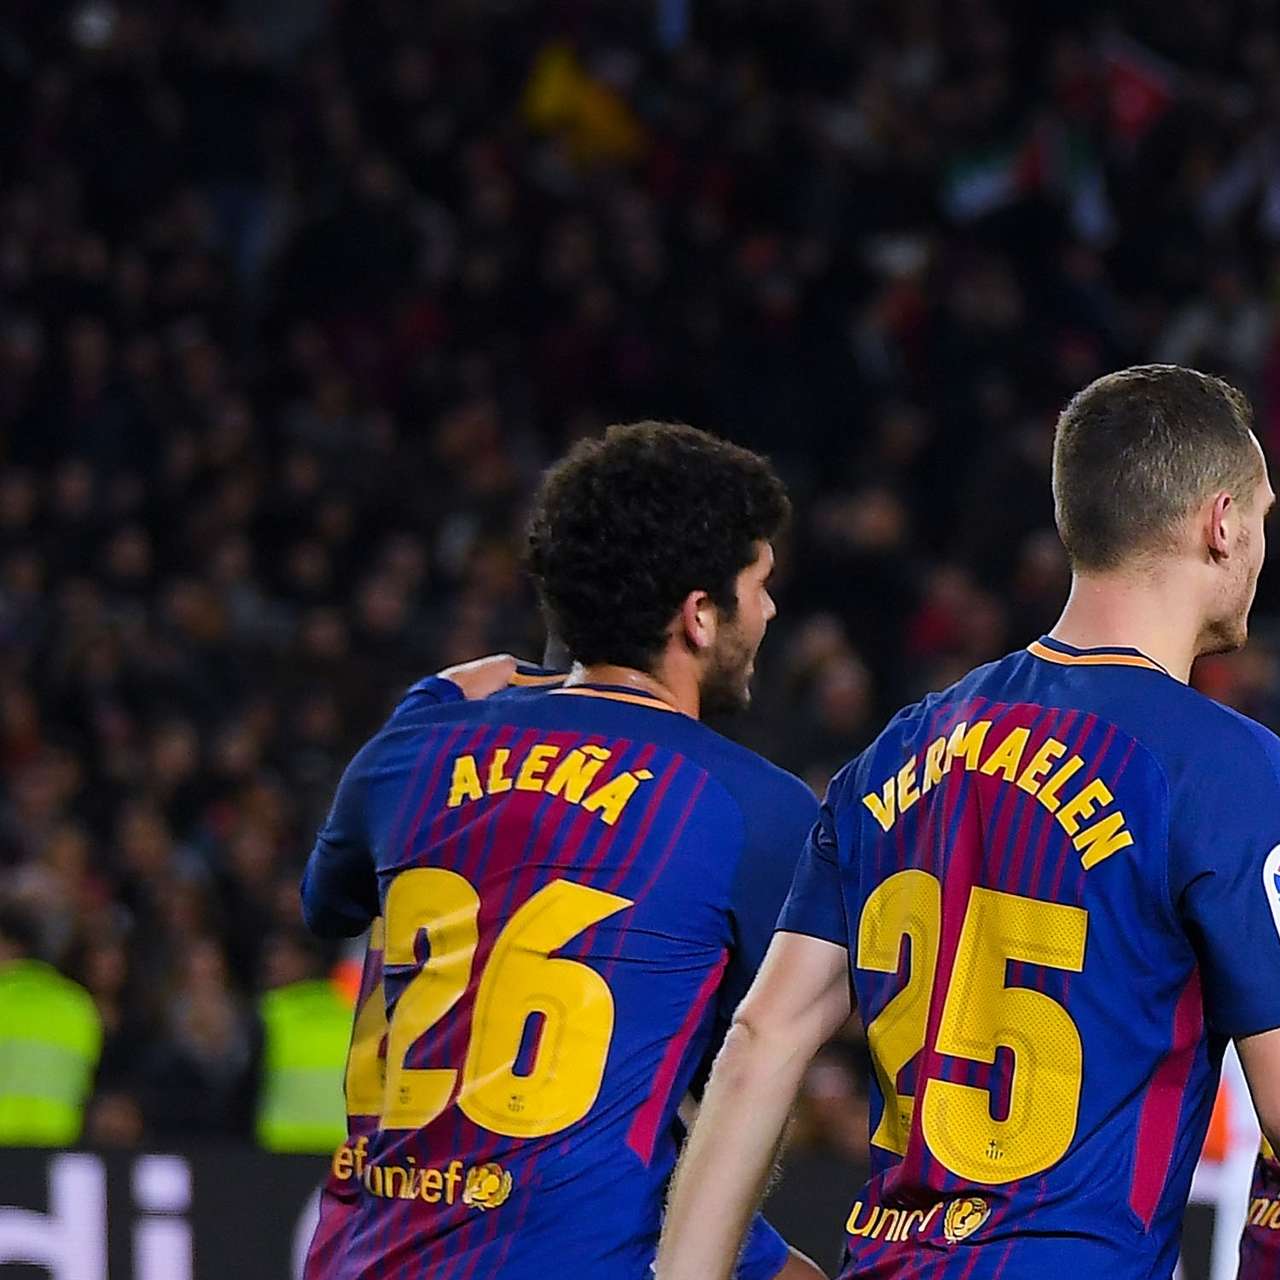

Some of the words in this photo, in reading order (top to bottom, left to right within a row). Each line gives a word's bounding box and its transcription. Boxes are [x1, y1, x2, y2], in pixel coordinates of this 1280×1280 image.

[448, 745, 654, 826] ALEÑÁ
[863, 721, 1135, 870] VERMAELEN
[380, 867, 635, 1139] 26
[857, 868, 1090, 1185] 25
